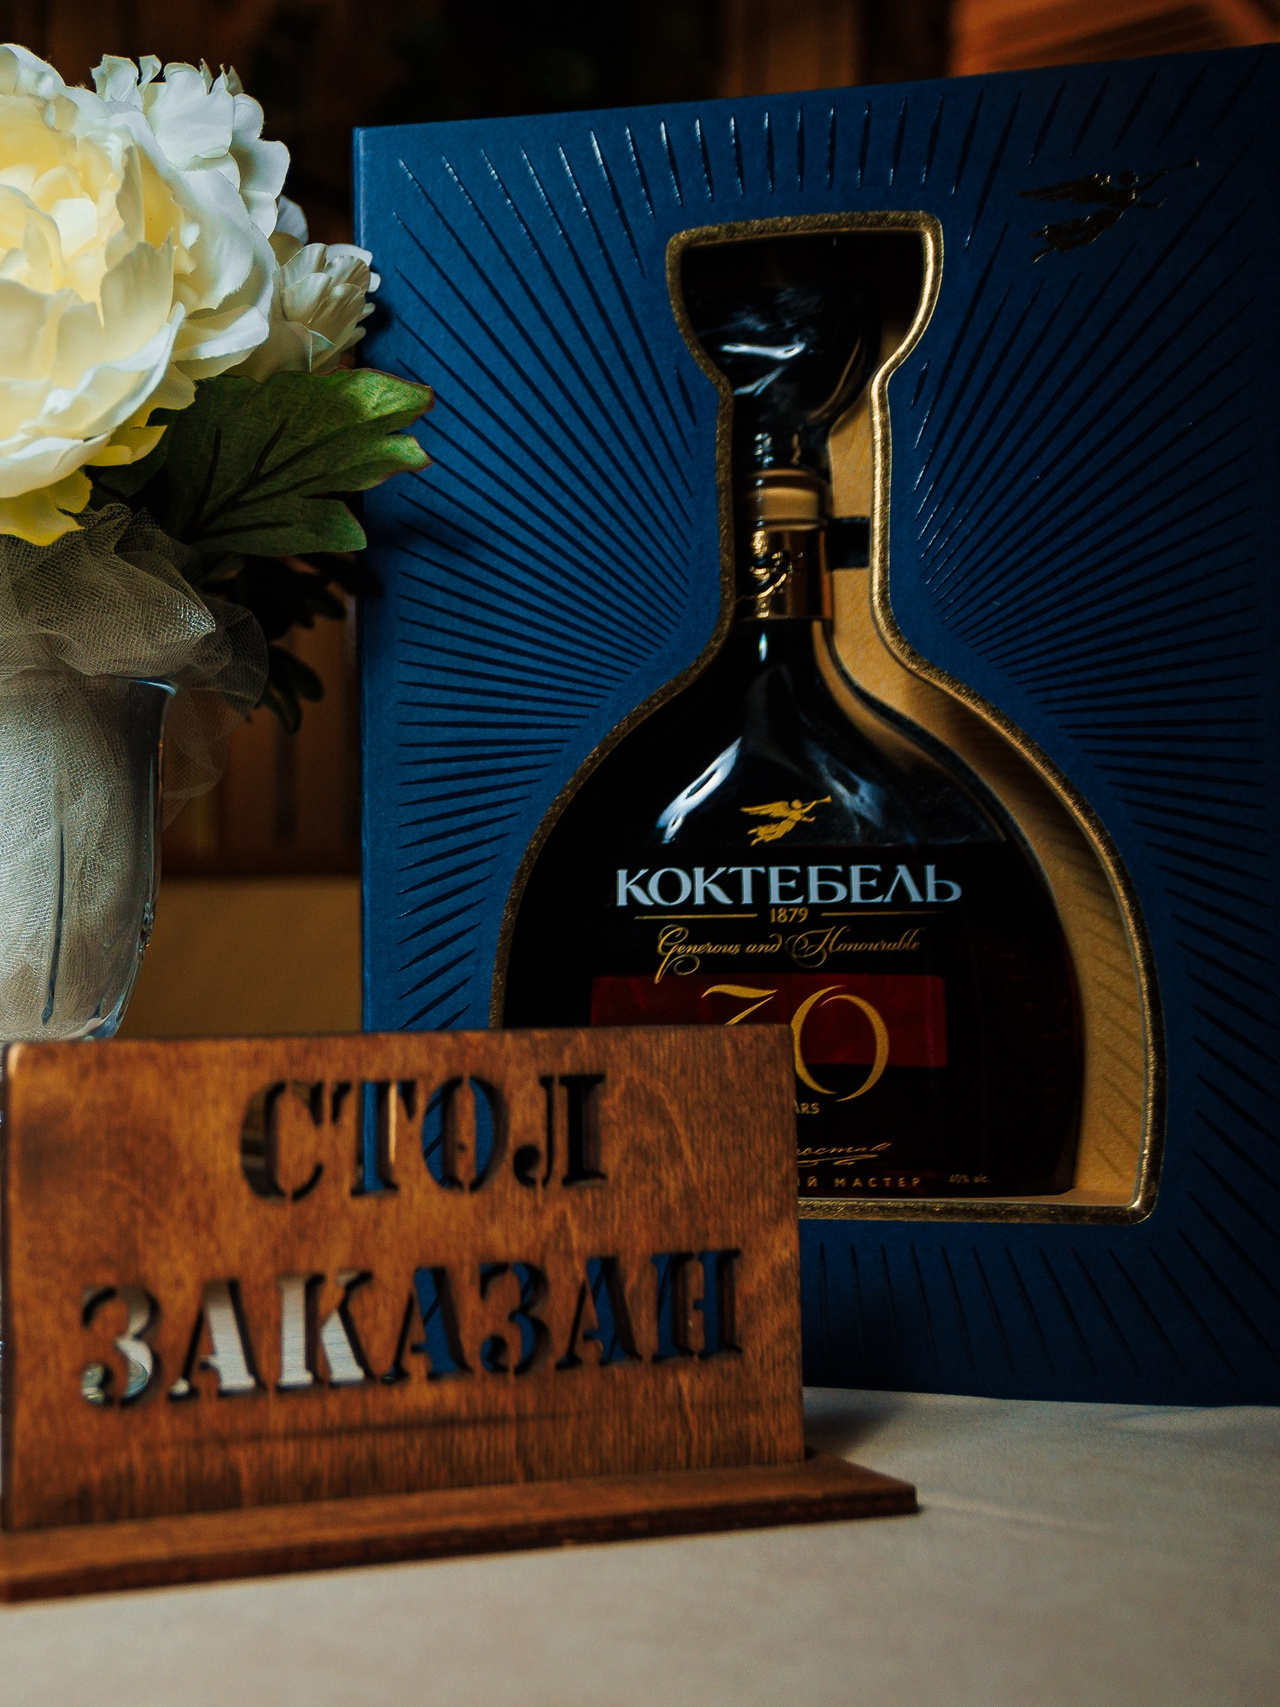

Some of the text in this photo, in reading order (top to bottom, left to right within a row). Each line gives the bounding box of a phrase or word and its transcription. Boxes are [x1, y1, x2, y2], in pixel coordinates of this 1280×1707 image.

[616, 864, 962, 906] КОКТЕБЕЛЬ
[770, 907, 809, 924] 1879
[654, 924, 926, 984] Generous and Honourable
[240, 1074, 607, 1201] СТОЛ
[834, 1177, 921, 1188] МАСТЕР
[80, 1250, 742, 1405] ЗАКАЗАН
